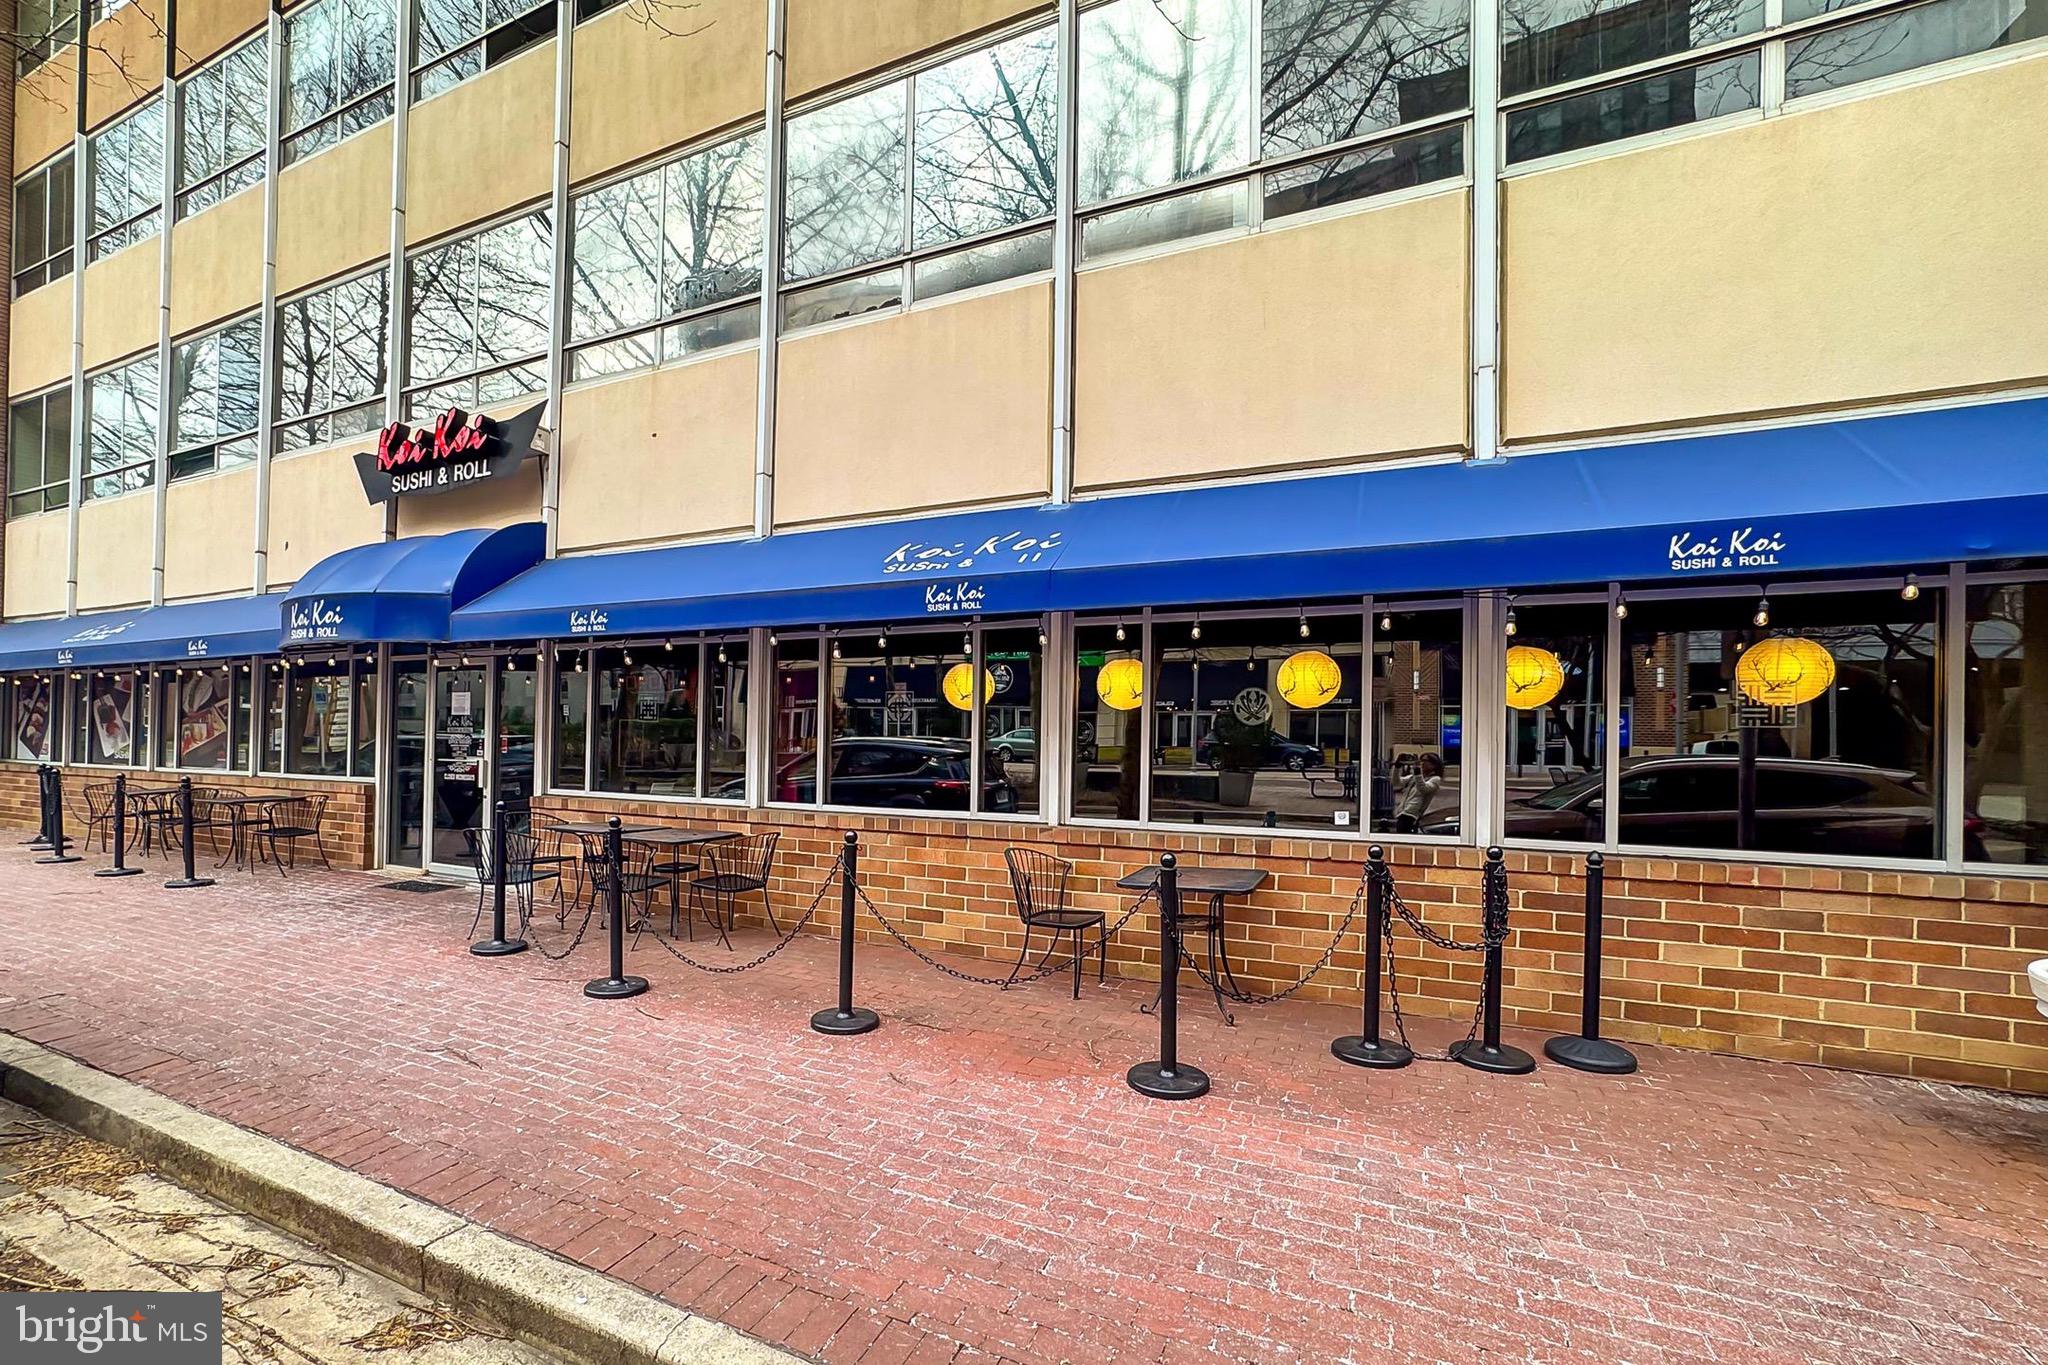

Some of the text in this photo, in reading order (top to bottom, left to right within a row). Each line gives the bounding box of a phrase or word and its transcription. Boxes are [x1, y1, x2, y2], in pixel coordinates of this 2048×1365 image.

[376, 406, 489, 470] Koi Koi
[391, 460, 492, 493] SUSHI & ROLL
[883, 531, 1062, 563] Koi Koi
[1668, 527, 1786, 559] Koi Koi
[958, 558, 973, 568] &
[1671, 554, 1779, 570] SUSHI & ROLL
[926, 581, 985, 604] Koi Koi
[291, 599, 344, 628] Koi Koi
[570, 609, 608, 626] Koi Koi
[927, 601, 982, 612] SUSHI & ROLL
[308, 628, 314, 638] &
[316, 627, 339, 637] ROLL
